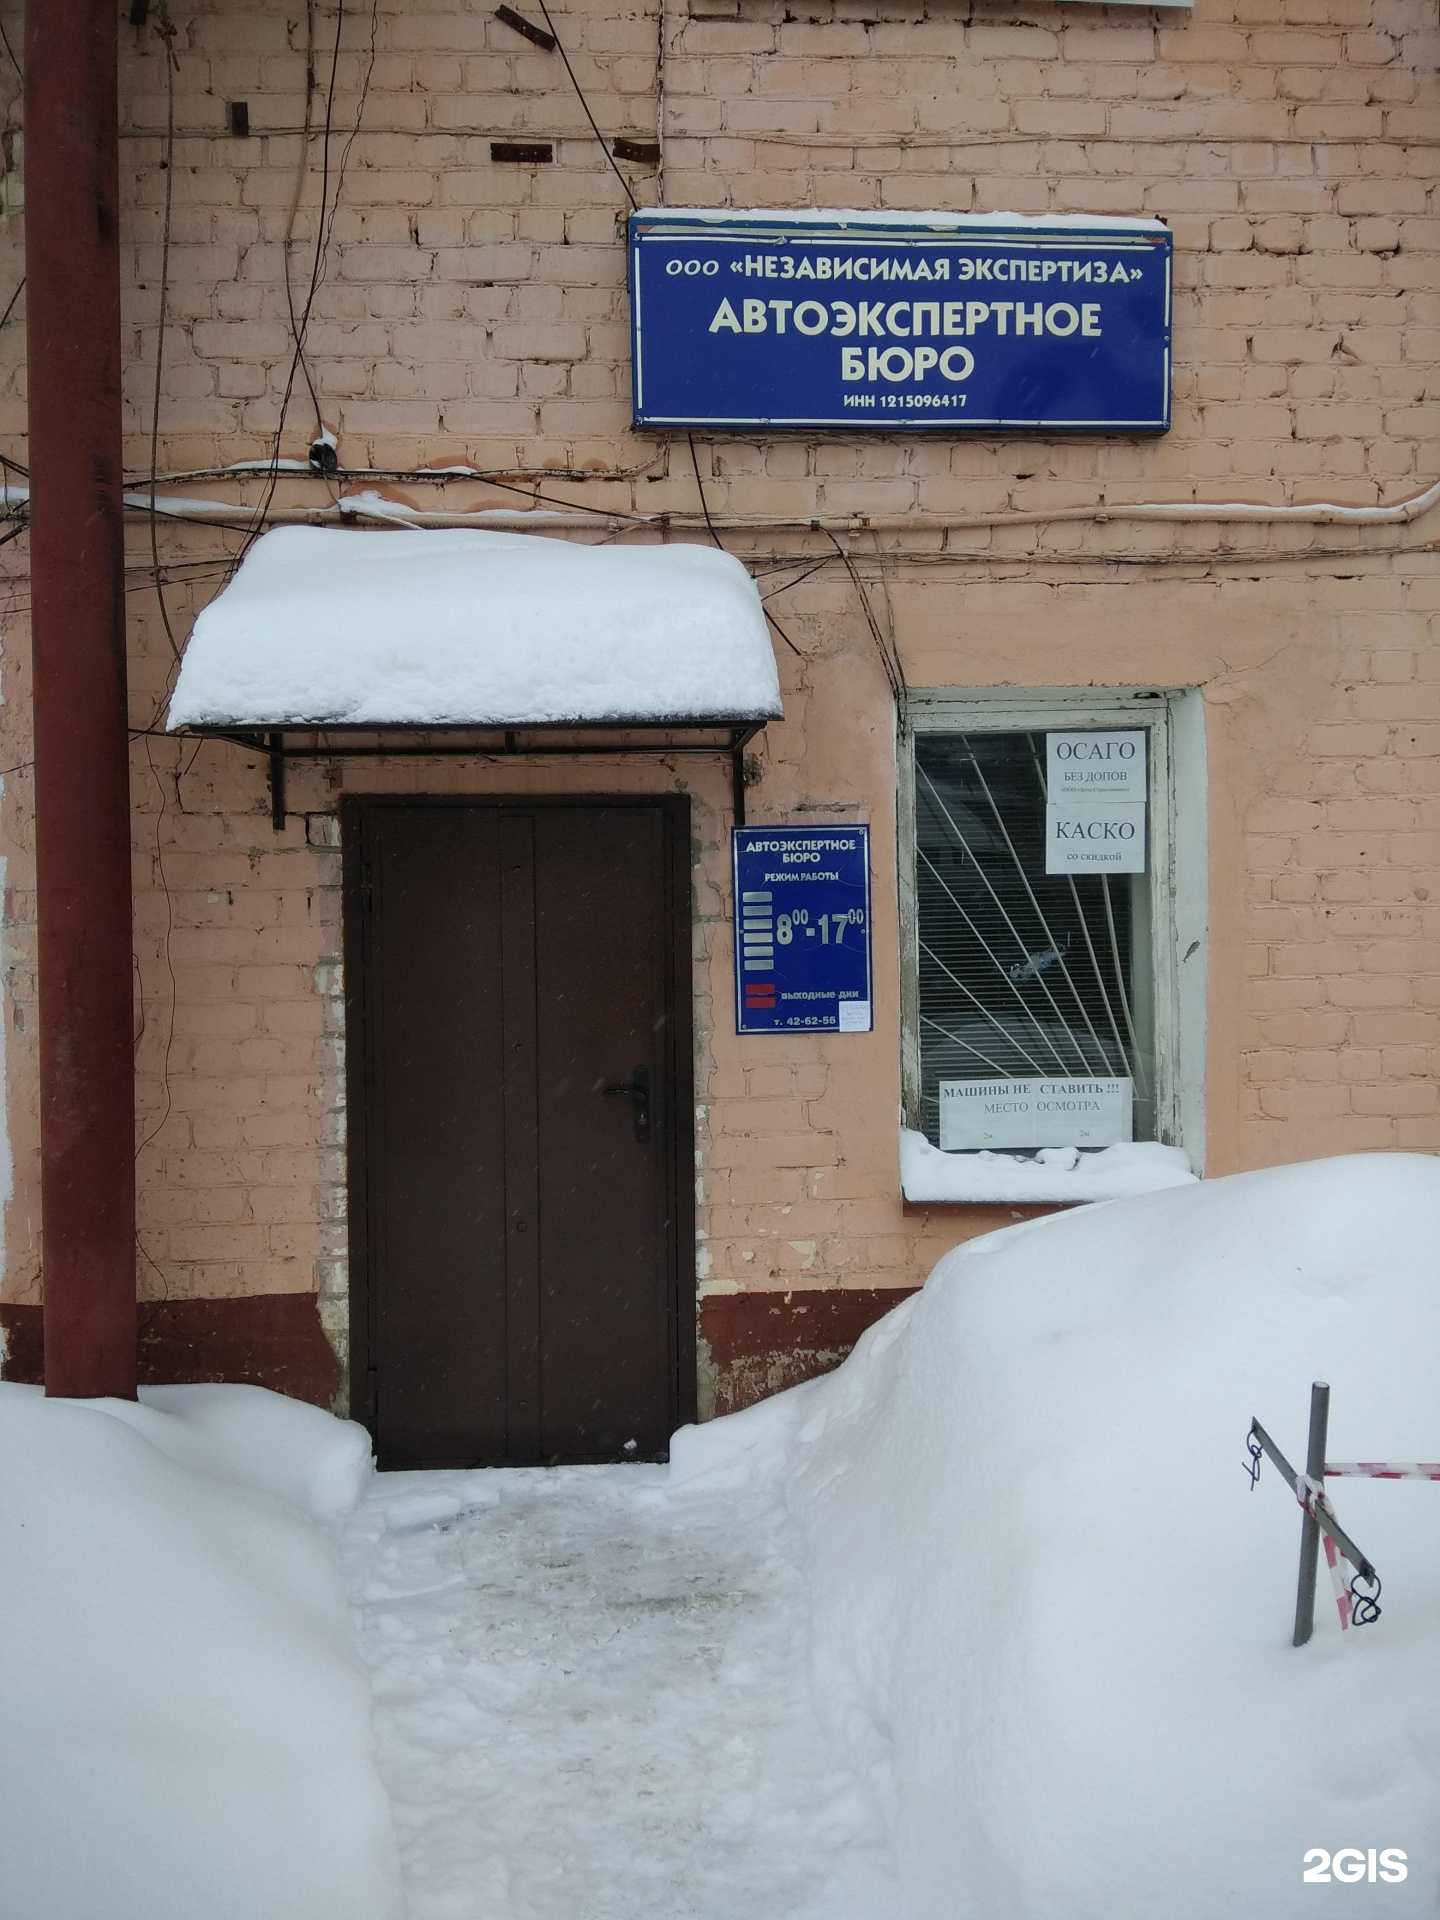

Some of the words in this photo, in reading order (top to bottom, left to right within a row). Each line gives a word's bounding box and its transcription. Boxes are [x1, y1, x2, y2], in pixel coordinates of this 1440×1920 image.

[730, 255, 950, 281] «НЕЗАВИСИМАЯ
[958, 258, 1142, 284] ЭКСПЕРТИЗА»
[708, 297, 1102, 337] АВТОЭКСПЕРТНОЕ
[841, 345, 975, 382] БЮРО
[843, 394, 876, 408] ИНН
[879, 394, 967, 409] 1215096417
[1057, 742, 1135, 760] ОСАГО
[1086, 771, 1127, 782] ДОПОВ
[1056, 821, 1135, 840] КАСКО
[746, 839, 856, 852] АВТОЭКСПЕРТНОЕ
[782, 852, 821, 863] БЮРО
[765, 872, 799, 882] РЕЖИМ
[801, 872, 839, 881] РАБОТЫ
[943, 1085, 1009, 1098] МАШИНЫ
[1013, 1084, 1032, 1095] НЕ
[984, 1102, 1029, 1114] МЕСТО
[1036, 1100, 1101, 1113] ОСМОТРА
